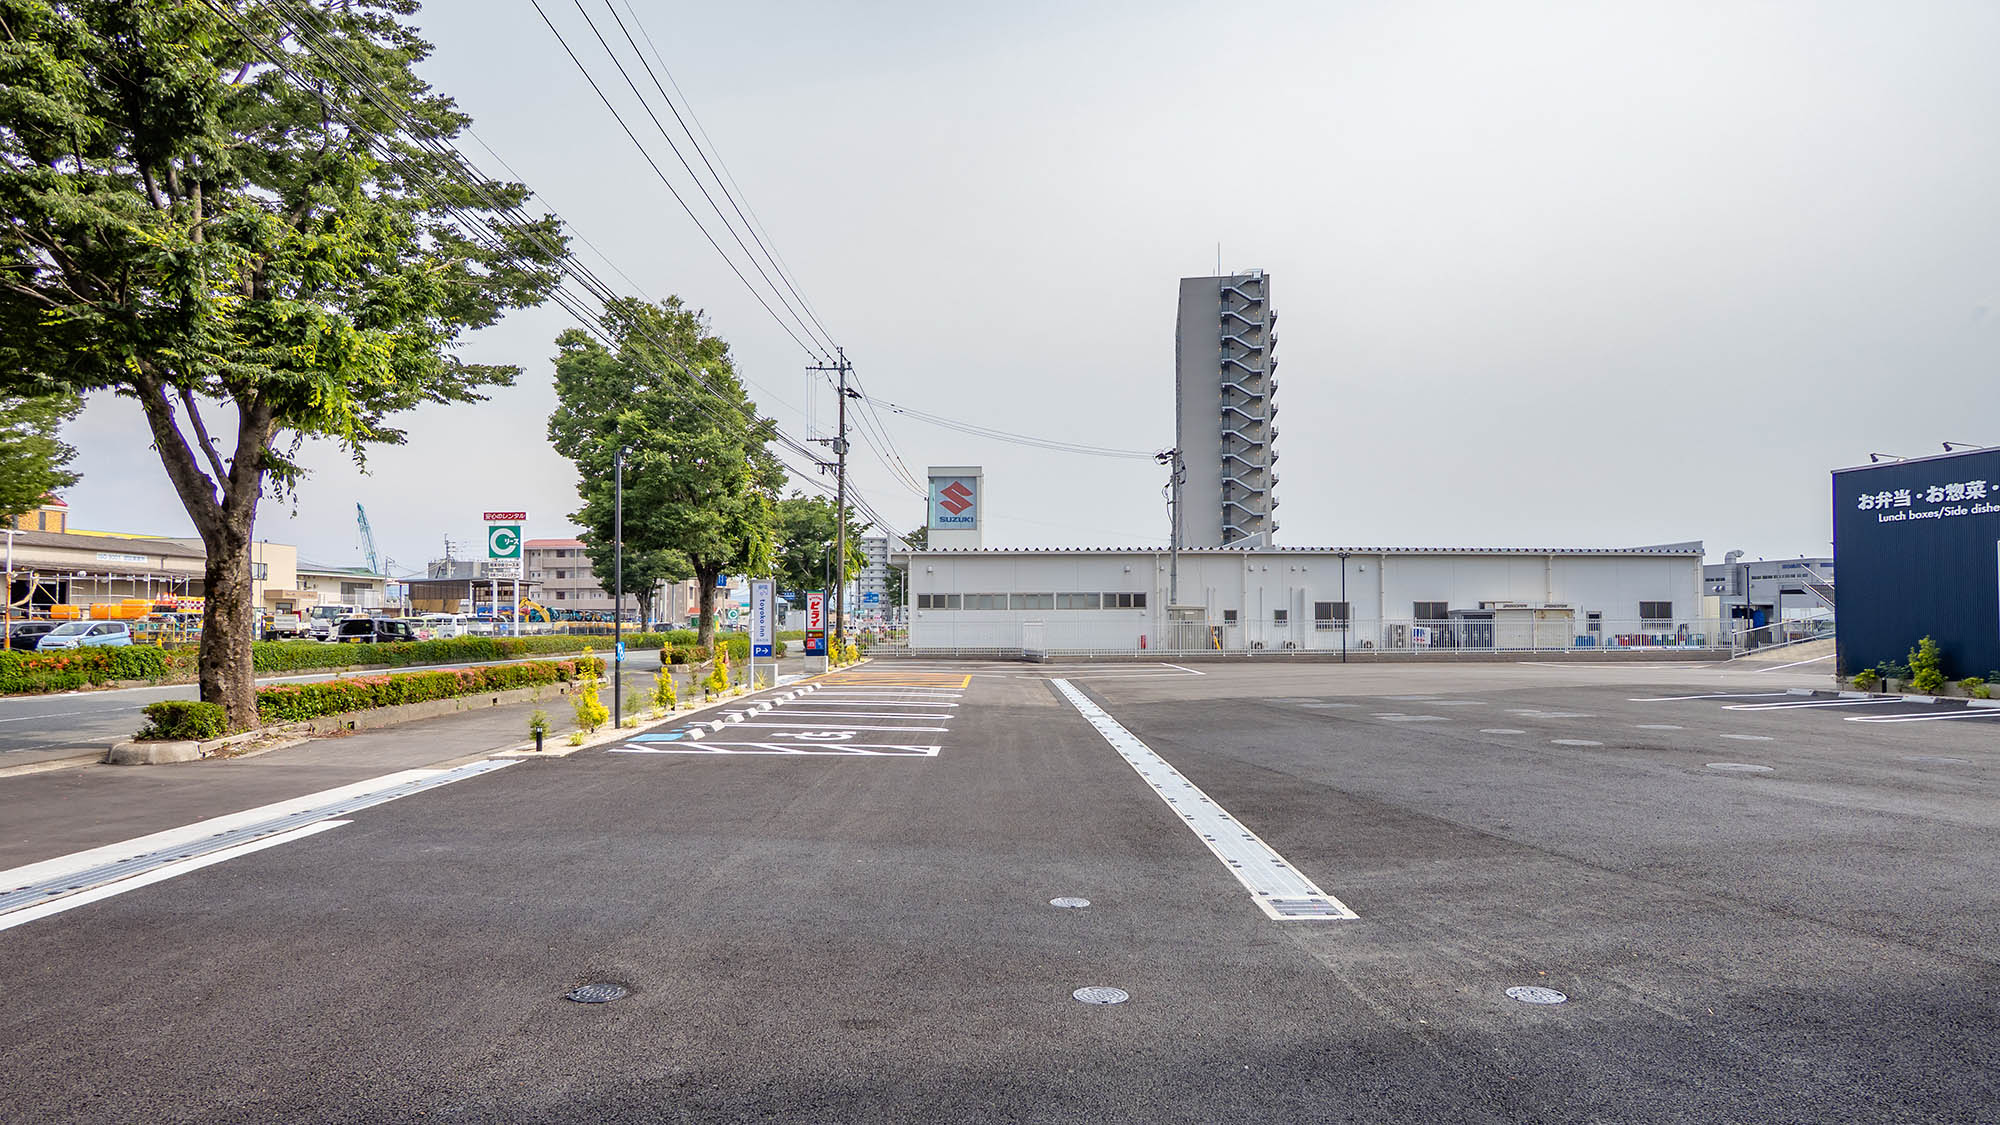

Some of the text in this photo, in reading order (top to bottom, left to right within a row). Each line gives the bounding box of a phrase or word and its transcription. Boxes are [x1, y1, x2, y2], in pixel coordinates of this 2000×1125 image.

[1878, 511, 1906, 522] Lunch
[1909, 505, 1968, 520] boxes/Side
[758, 599, 766, 624] toyoko
[810, 601, 821, 627] ヒライ
